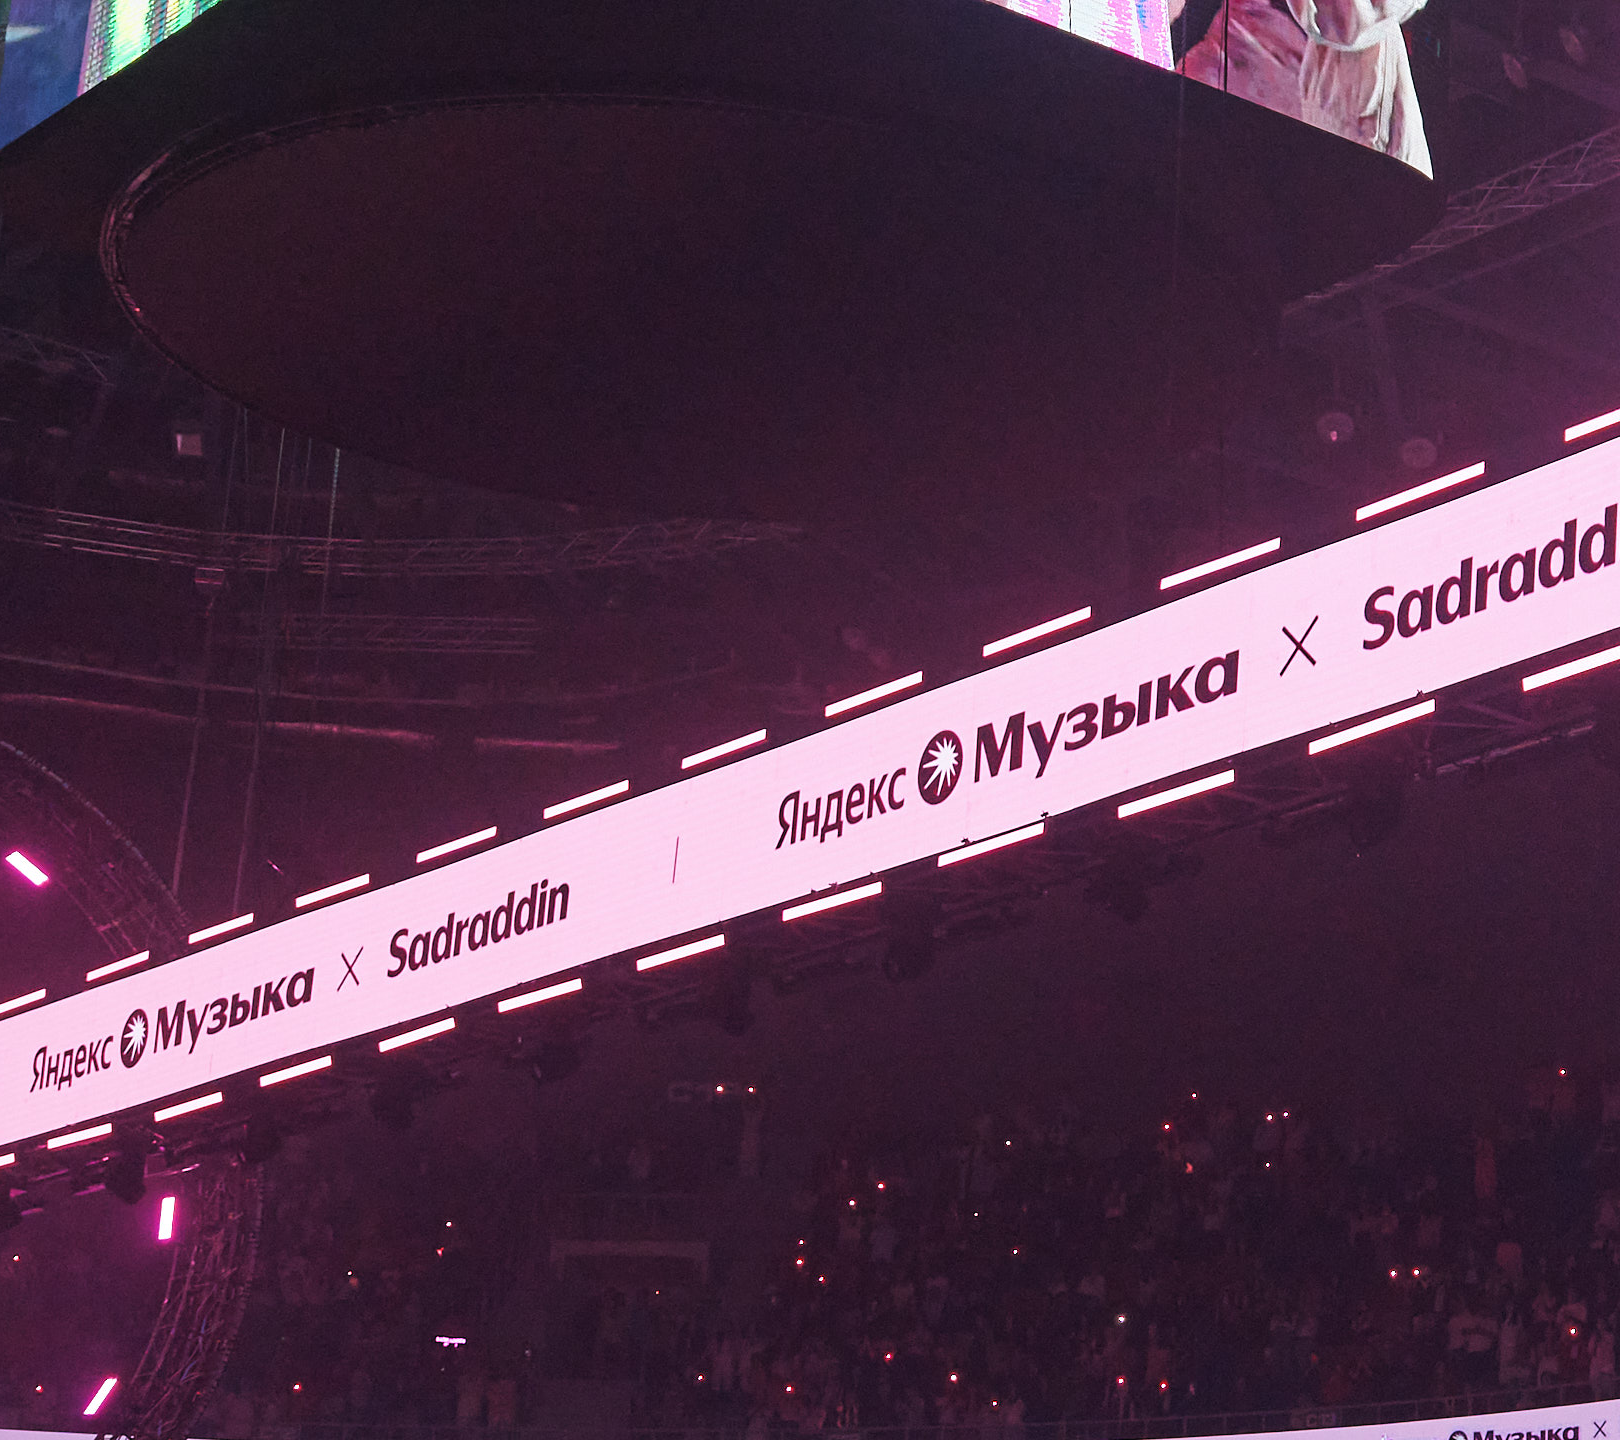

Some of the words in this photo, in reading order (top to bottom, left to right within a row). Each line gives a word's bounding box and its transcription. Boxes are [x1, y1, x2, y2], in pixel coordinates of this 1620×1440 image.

[775, 768, 906, 850] Яндекс
[974, 650, 1239, 783] Музыка
[30, 1036, 113, 1092] Яндекс
[154, 968, 315, 1054] Музыка
[387, 879, 569, 978] Sadraddin
